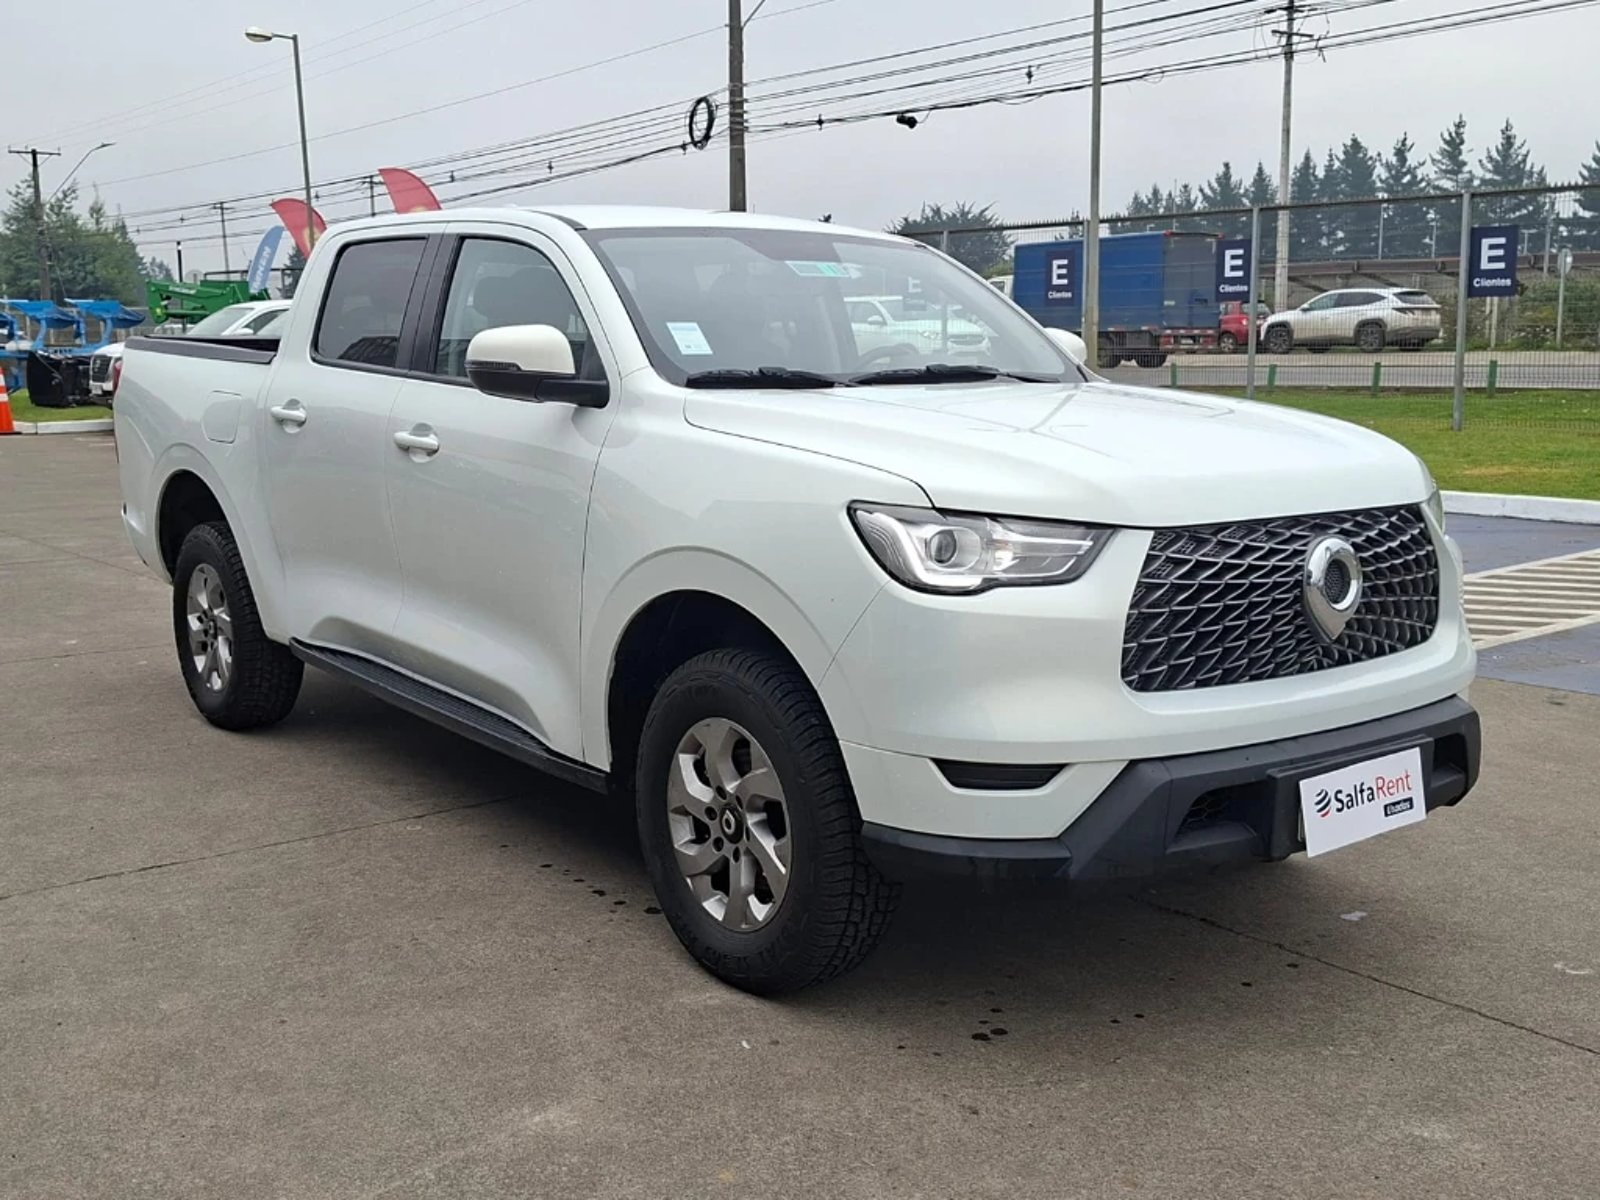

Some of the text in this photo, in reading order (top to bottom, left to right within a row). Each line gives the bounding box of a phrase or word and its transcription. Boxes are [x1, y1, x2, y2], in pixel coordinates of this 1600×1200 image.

[1225, 249, 1244, 277] E
[1480, 237, 1506, 269] E
[1052, 259, 1068, 285] E
[1473, 277, 1511, 288] Clientes
[1219, 284, 1248, 293] Clientes
[1334, 770, 1412, 813] SalfaRent
